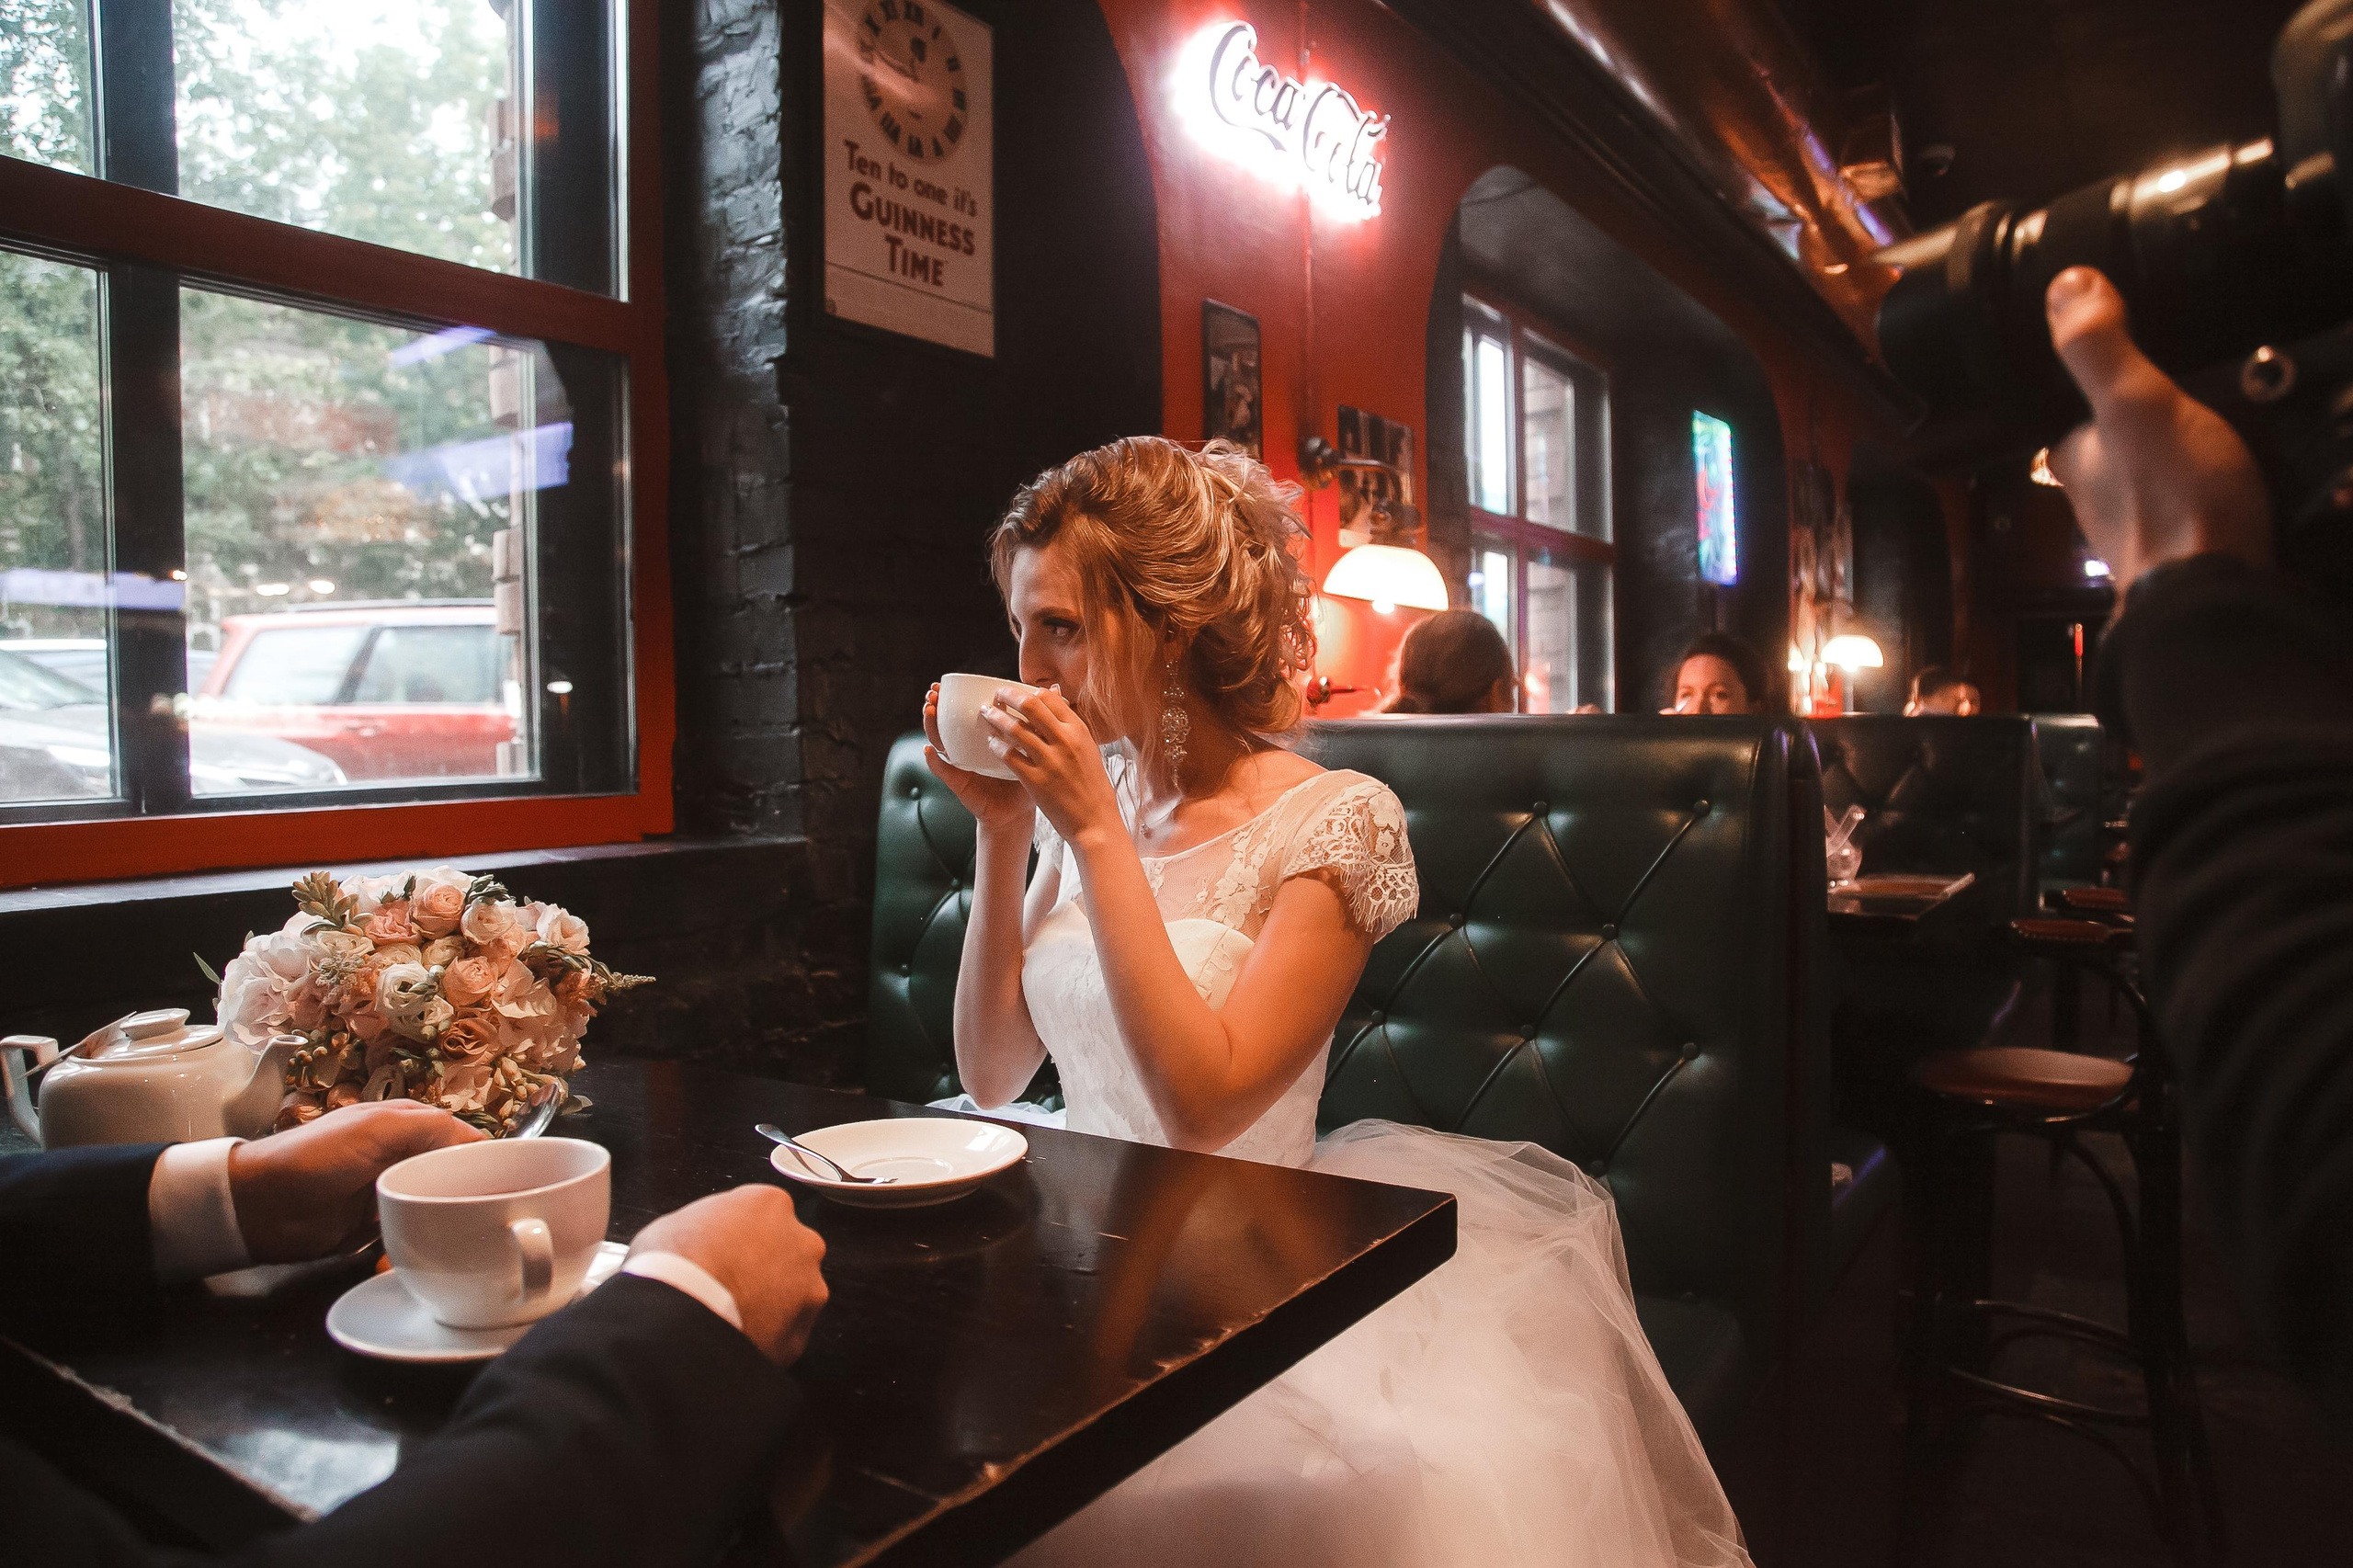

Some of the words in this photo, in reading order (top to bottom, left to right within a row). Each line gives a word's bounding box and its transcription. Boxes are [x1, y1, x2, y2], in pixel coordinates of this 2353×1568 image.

[845, 140, 881, 181] Ten
[889, 162, 909, 189] to
[914, 178, 948, 205] one
[850, 182, 975, 256] GUINNESS
[885, 234, 944, 287] TIME
